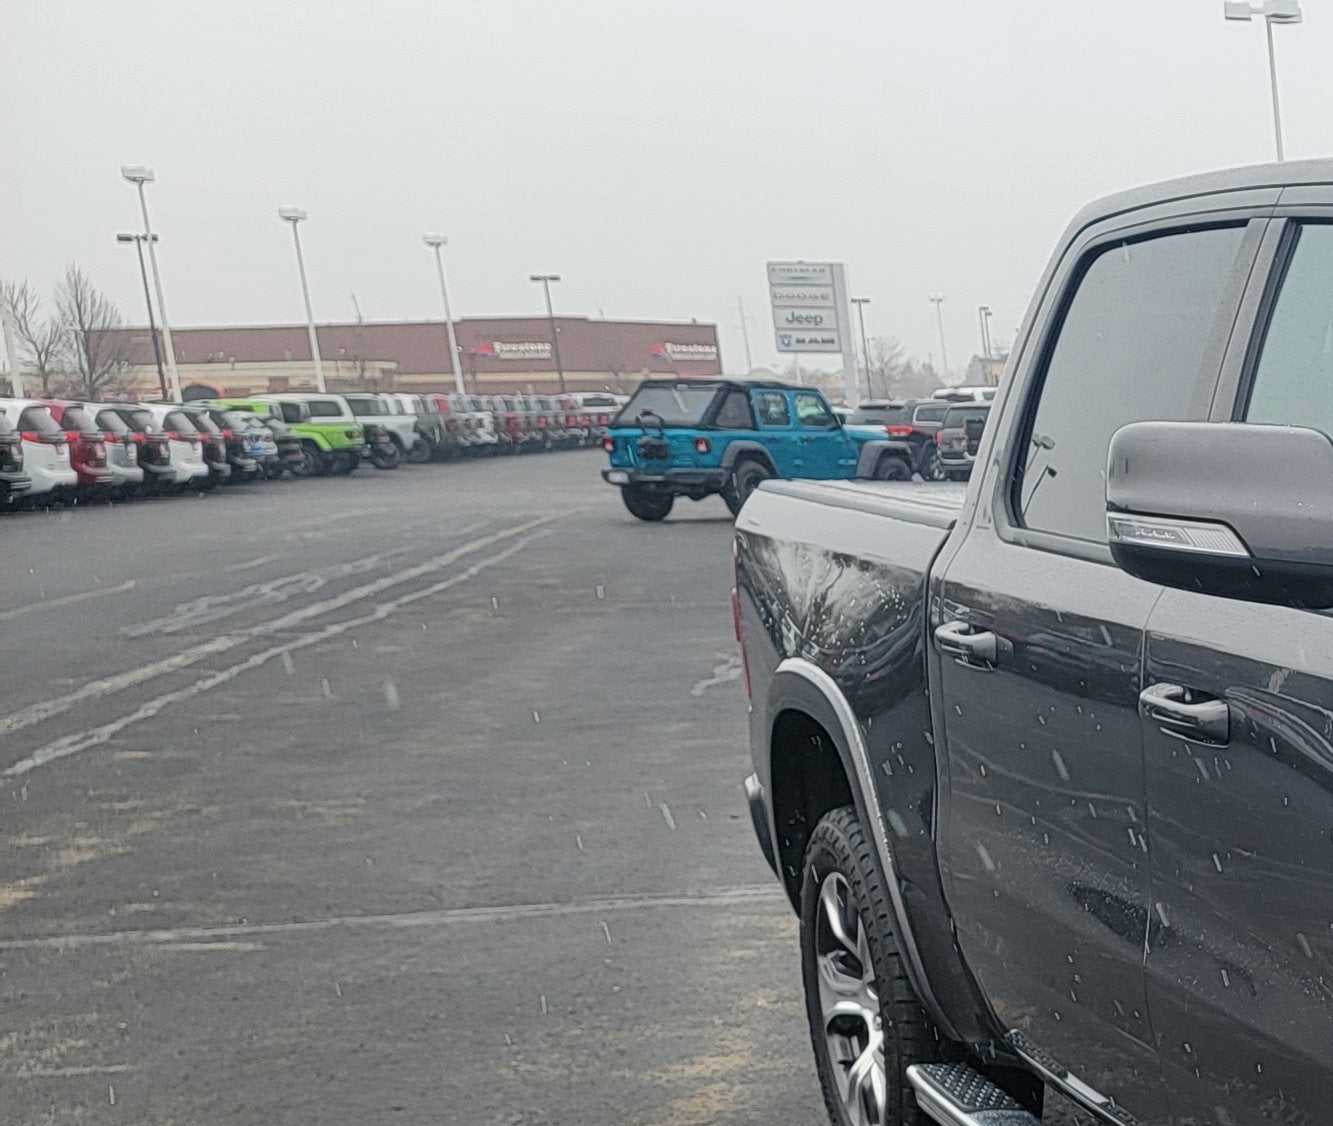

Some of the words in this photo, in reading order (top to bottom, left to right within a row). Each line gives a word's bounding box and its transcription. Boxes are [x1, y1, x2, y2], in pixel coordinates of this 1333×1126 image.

[785, 310, 824, 326] Jeep
[493, 341, 552, 352] Firestone
[664, 342, 717, 353] Firestone
